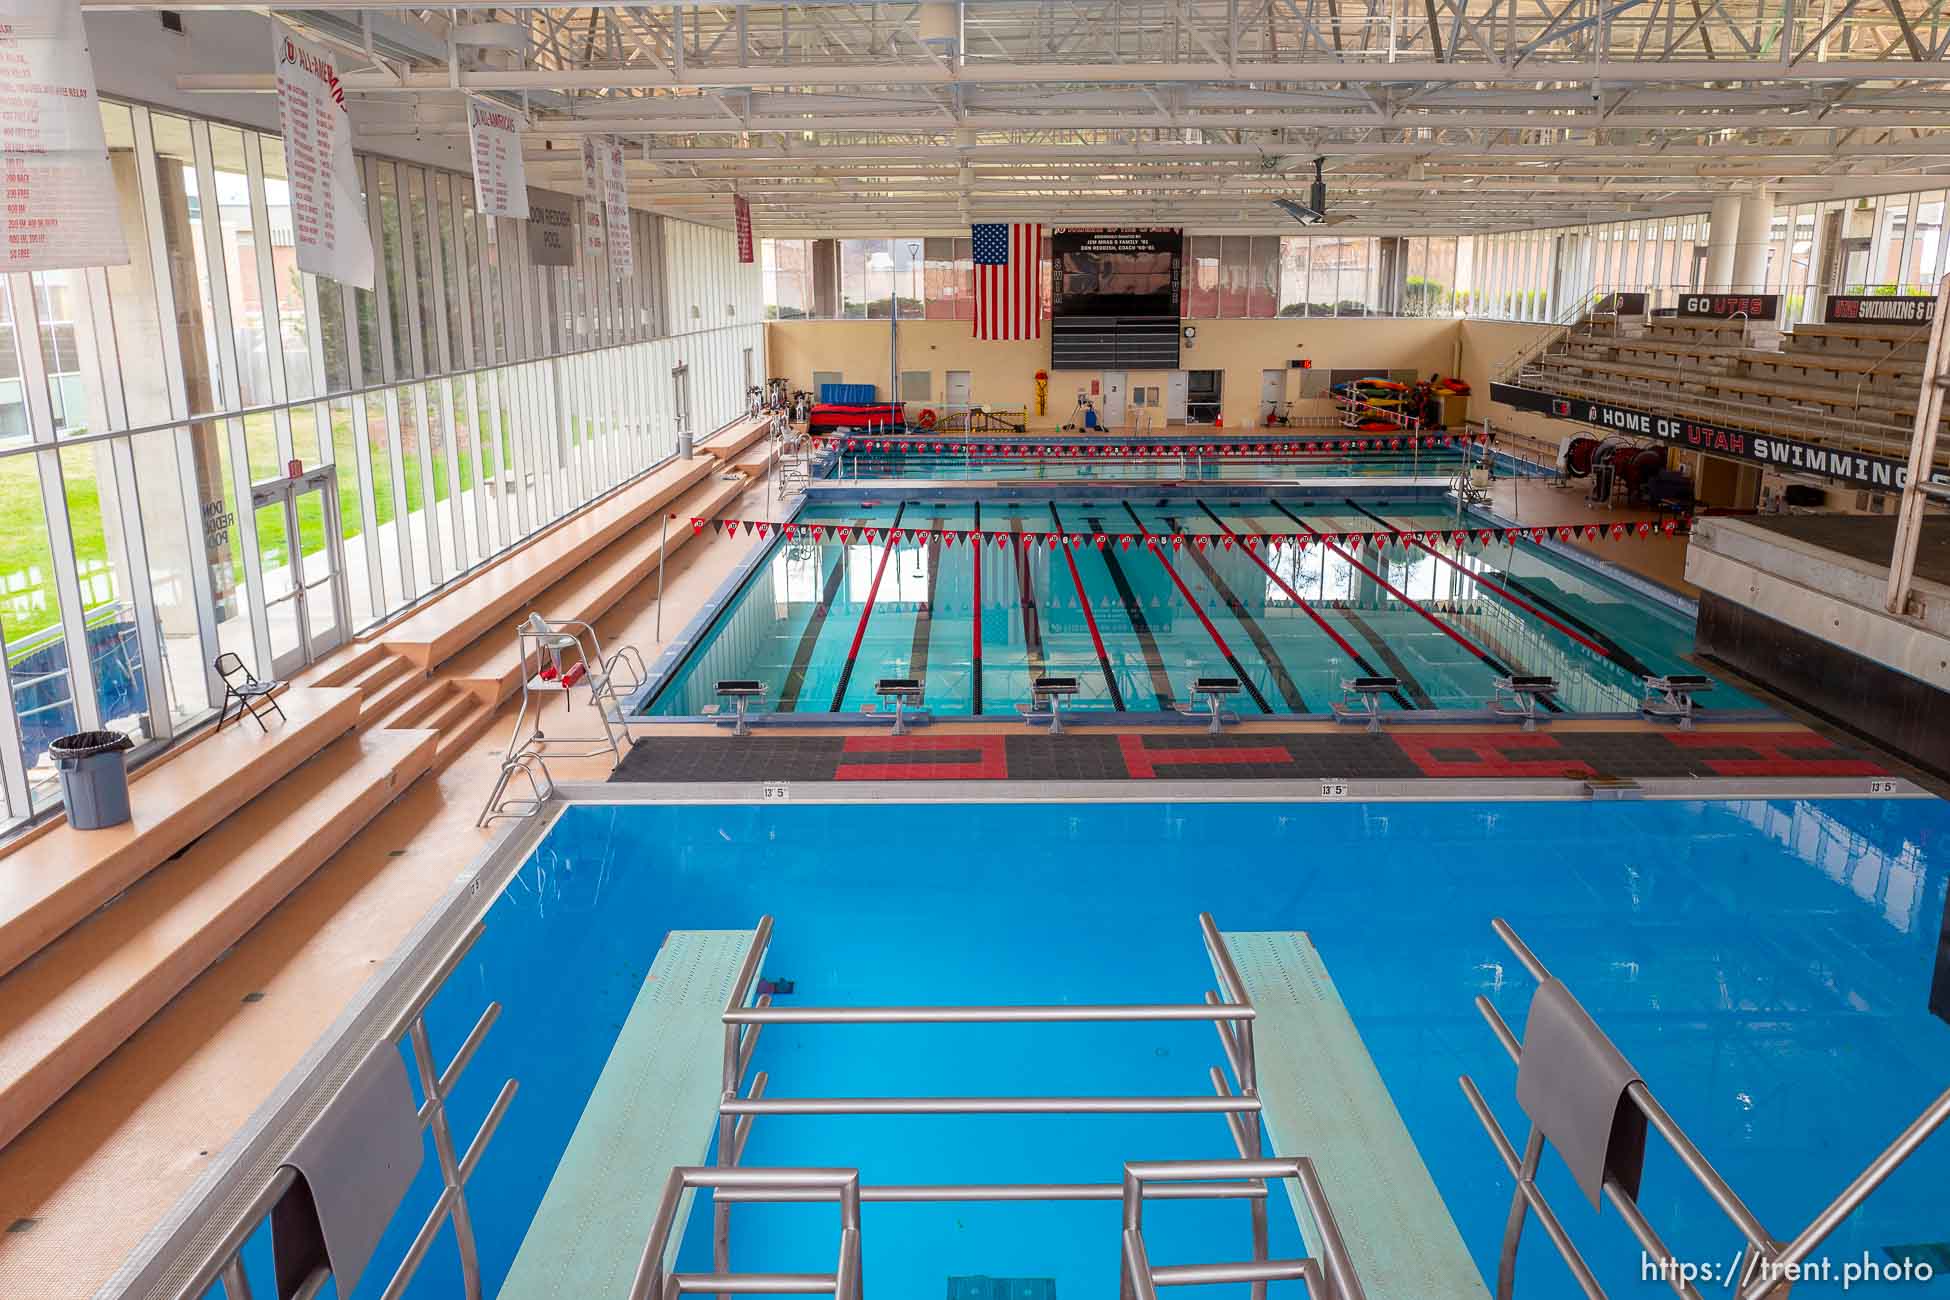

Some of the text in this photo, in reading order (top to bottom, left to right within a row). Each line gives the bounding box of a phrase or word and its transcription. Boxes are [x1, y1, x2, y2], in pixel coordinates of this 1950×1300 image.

[1687, 298, 1763, 315] GO UTES
[1859, 301, 1916, 320] SWIMMING
[1916, 302, 1925, 321] &
[1603, 409, 1650, 433] HOME
[1657, 419, 1681, 439] OF
[1687, 424, 1745, 454] UTAH
